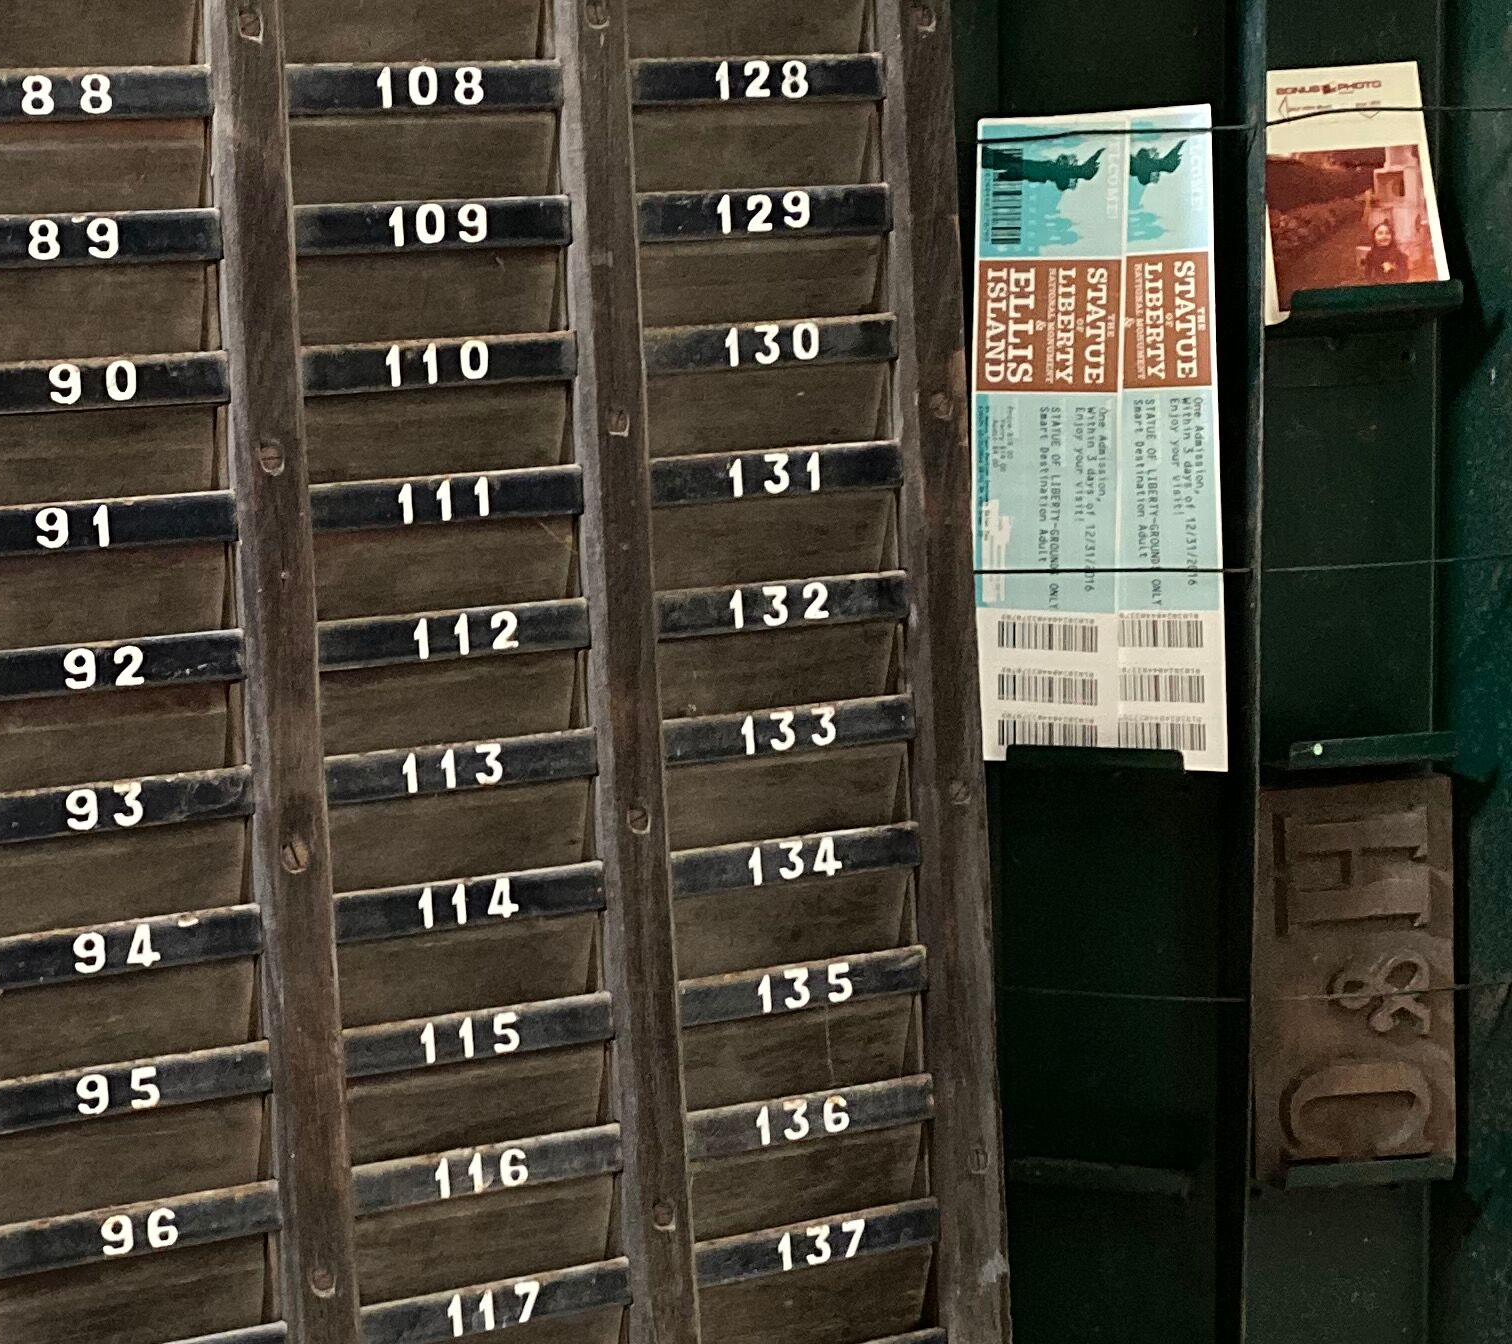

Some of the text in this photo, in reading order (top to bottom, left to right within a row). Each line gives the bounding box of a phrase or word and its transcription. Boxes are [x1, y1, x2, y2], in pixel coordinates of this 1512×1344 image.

[377, 62, 483, 108] 108
[716, 60, 808, 100] 128
[1276, 79, 1383, 96] BONUS PHOTO
[389, 204, 487, 246] 109
[717, 191, 809, 234] 129
[28, 218, 118, 260] 89
[984, 267, 1008, 383] ISLAND
[1006, 267, 1036, 383] ELLIS
[1035, 320, 1046, 331] &
[1045, 267, 1057, 384] NATIONAL MONUMENT
[1055, 267, 1076, 384] LIBERTY
[1076, 317, 1085, 332] OF
[1084, 267, 1108, 384] STATUE
[1106, 314, 1116, 338] THE
[1134, 263, 1146, 380] NATIONAL MONUMENT
[1145, 262, 1165, 379] LIBERTY
[1164, 312, 1174, 328] OF
[1174, 260, 1198, 378] STATUE
[1197, 307, 1206, 331] THE
[49, 360, 136, 404] 90
[1050, 407, 1061, 446] STATUE
[1074, 407, 1086, 441] Enjoy
[1086, 407, 1096, 449] Within
[1098, 407, 1109, 428] One
[1145, 399, 1157, 440] STATUE
[1169, 398, 1181, 432] Enjoy
[1182, 397, 1193, 440] Within
[1193, 397, 1204, 418] One
[729, 452, 820, 497] 131
[1051, 454, 1061, 467] OF
[1074, 447, 1084, 475] your
[1147, 447, 1158, 461] OF
[1169, 440, 1181, 468] your
[1181, 460, 1193, 488] days
[1038, 407, 1050, 562] Smart Destination Adult
[1086, 468, 1097, 495] days
[1133, 399, 1149, 558] Smart Destination Adult
[1086, 503, 1096, 516] of
[1185, 496, 1196, 509] of
[36, 505, 109, 548] 91
[730, 582, 829, 629] 132
[1048, 583, 1060, 609] ONLY
[1151, 578, 1163, 606] ONLY
[414, 611, 518, 659] 112
[741, 704, 836, 755] 133
[403, 742, 502, 793] 113
[66, 781, 143, 830] 93
[419, 878, 518, 928] 114
[73, 923, 160, 973] 94
[758, 962, 852, 1013] 135
[77, 1066, 160, 1114] 95
[757, 1096, 849, 1145] 136
[436, 1149, 528, 1198] 116
[778, 1219, 865, 1271] 137
[445, 1279, 543, 1337] 117
